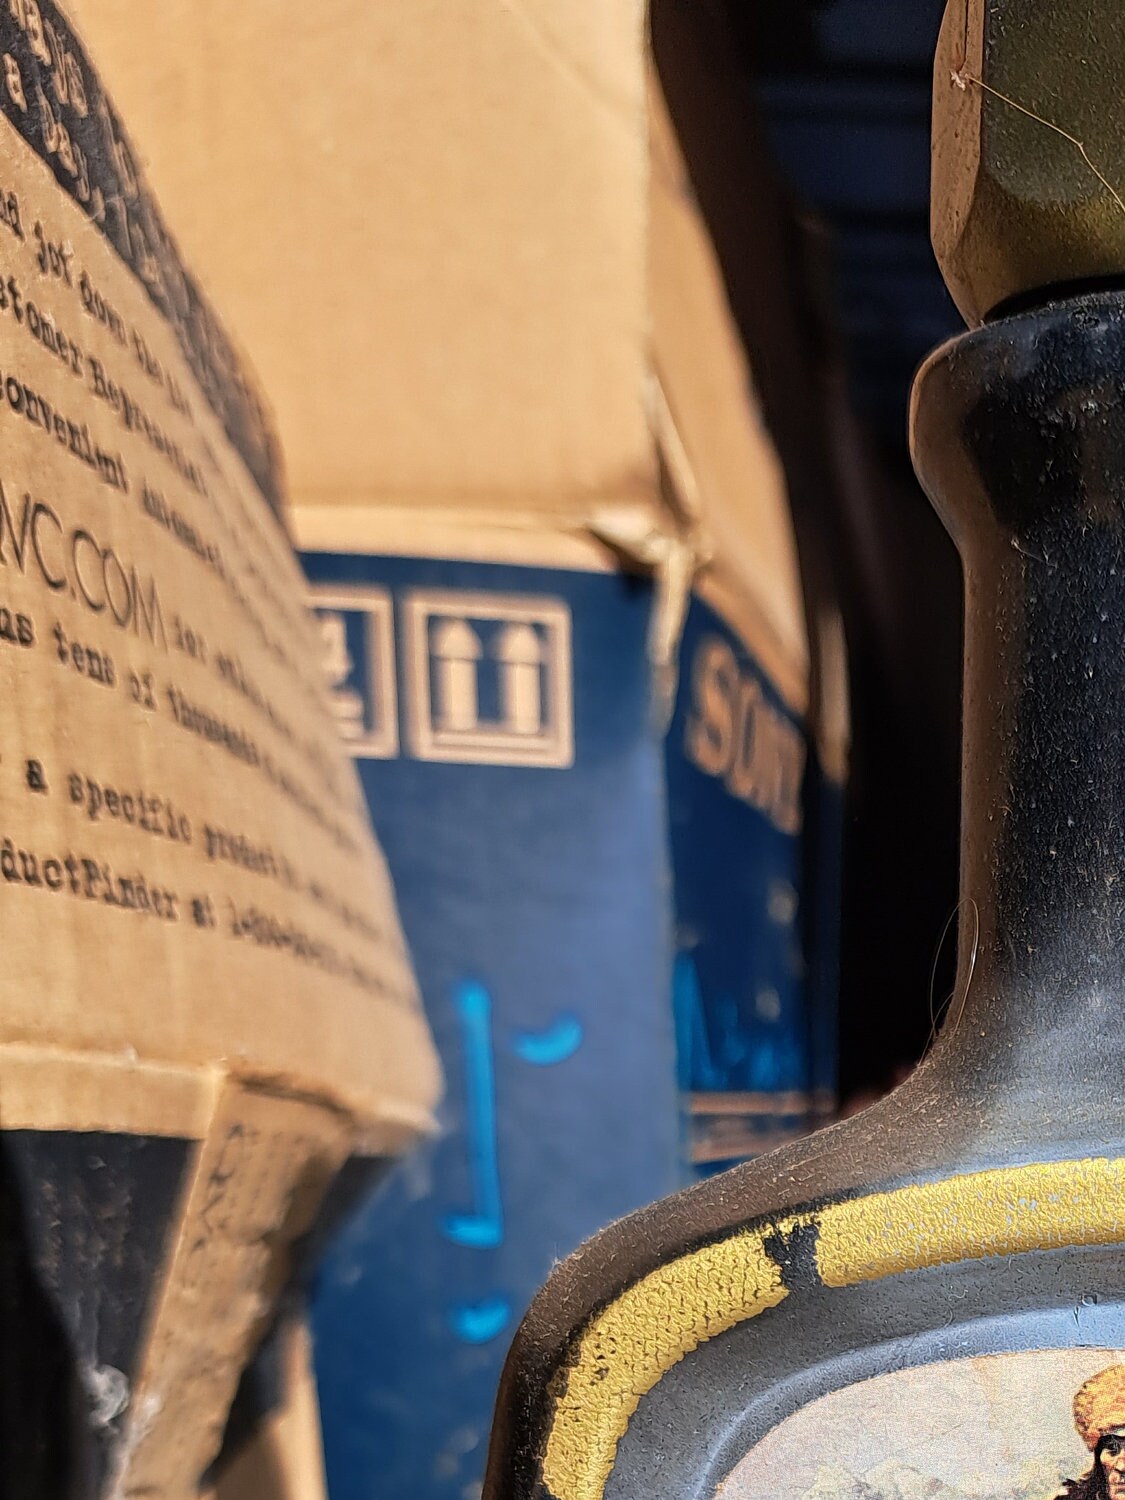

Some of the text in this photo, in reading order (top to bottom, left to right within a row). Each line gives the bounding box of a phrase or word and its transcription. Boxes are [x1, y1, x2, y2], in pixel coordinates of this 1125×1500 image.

[0, 366, 128, 495] onvenient
[0, 476, 168, 656] VC.COM
[53, 619, 116, 689] tens
[25, 757, 48, 793] a
[67, 771, 192, 845] specific
